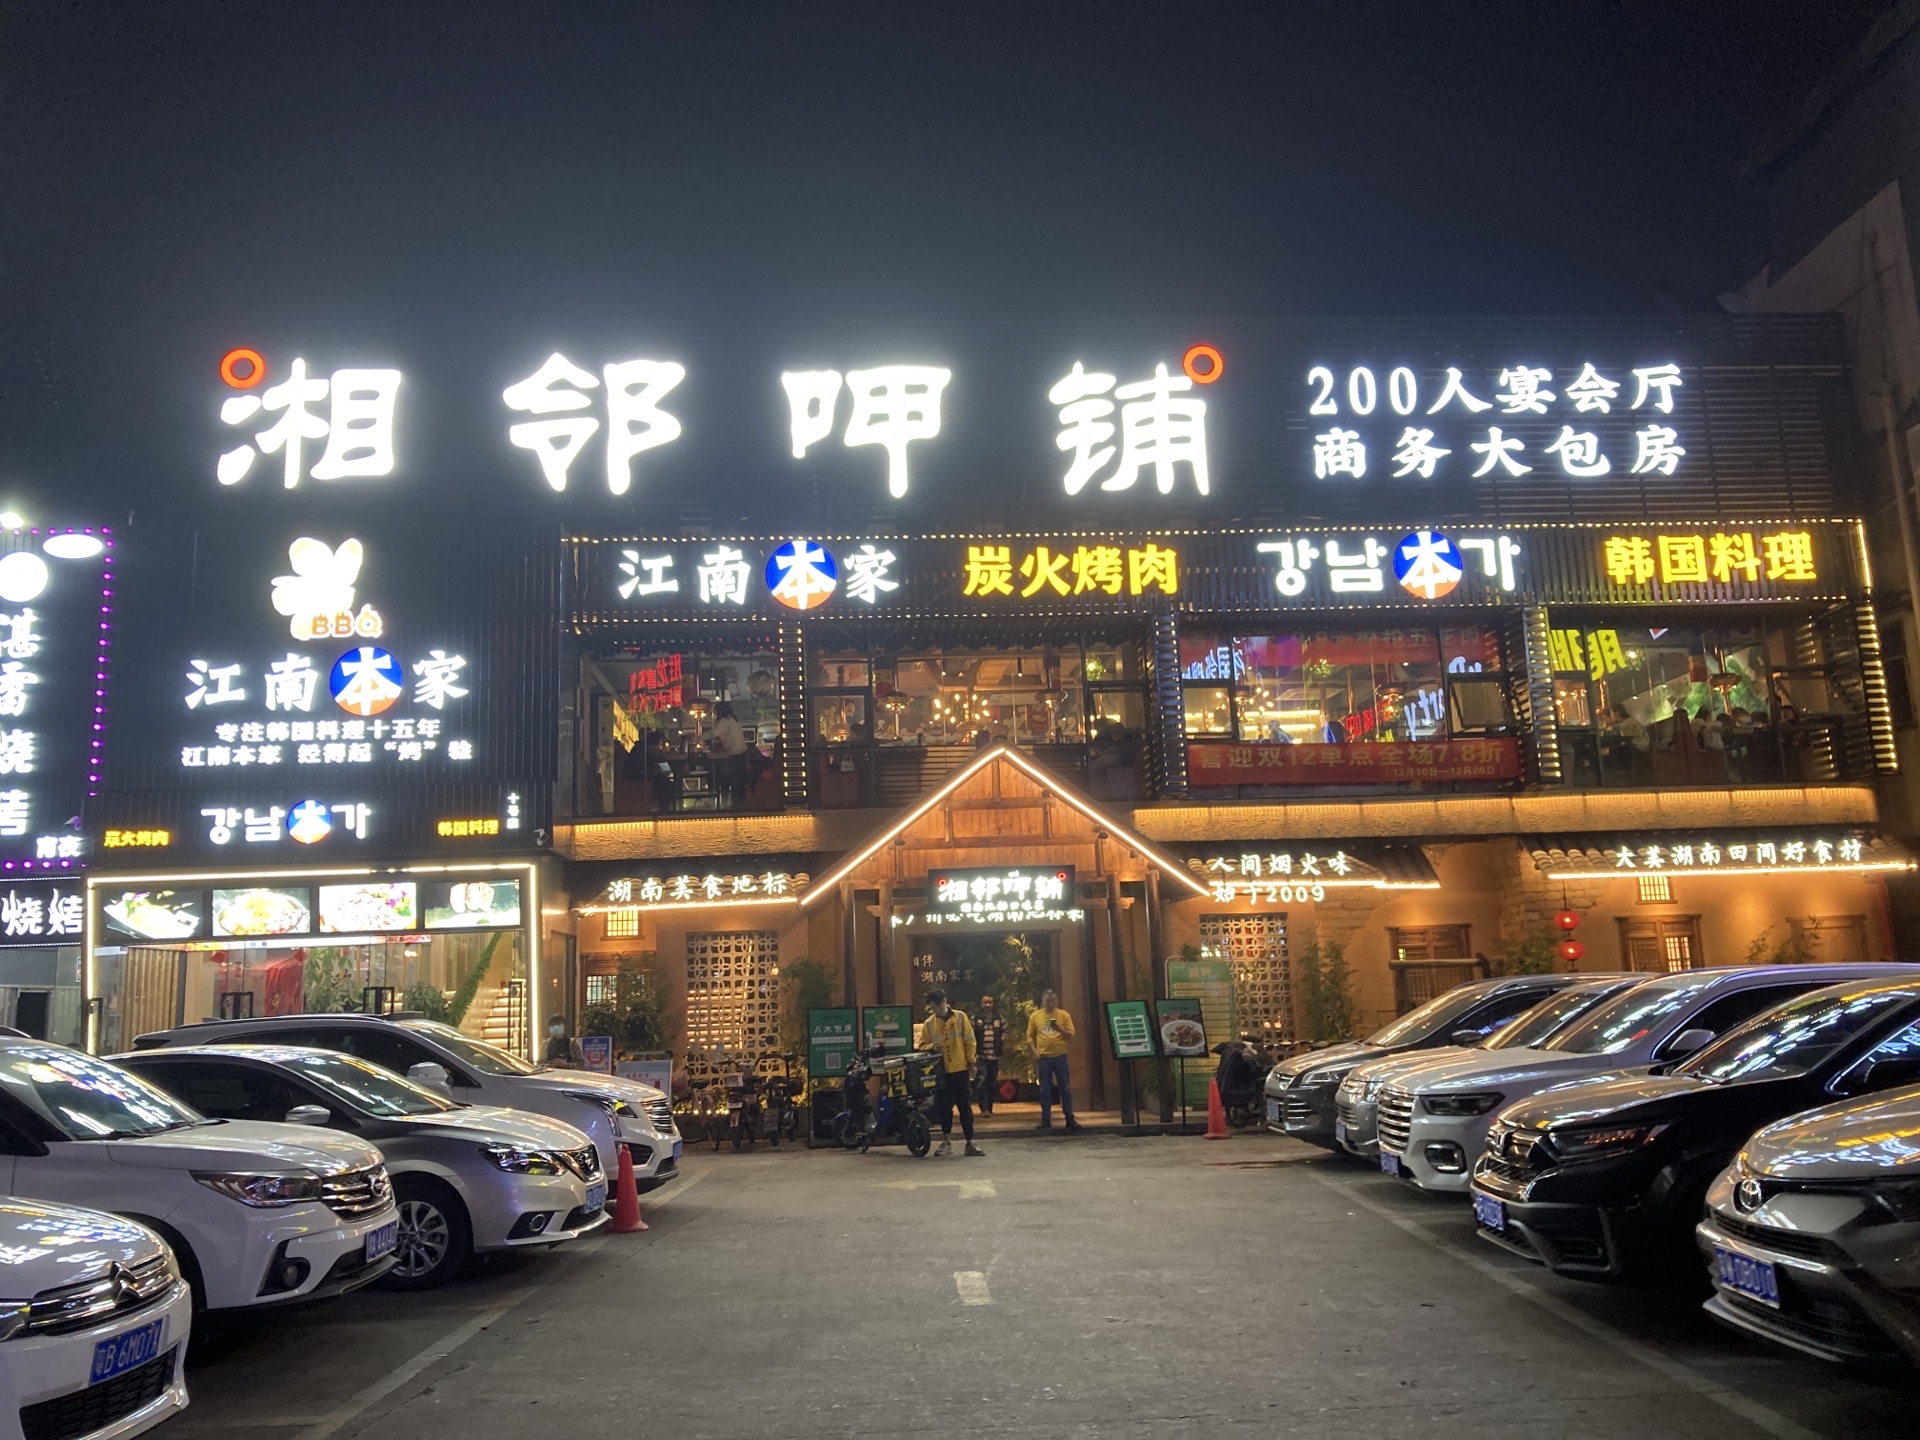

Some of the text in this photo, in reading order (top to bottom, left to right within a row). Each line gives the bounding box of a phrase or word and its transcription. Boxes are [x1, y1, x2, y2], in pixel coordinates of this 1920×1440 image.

[1308, 363, 1684, 415] 200人宴会厅
[217, 345, 1223, 497] 湘邻呷铺
[1313, 424, 1687, 480] 商务大包房
[963, 544, 1178, 598] 炭火烤肉
[1605, 532, 1817, 584] 韩国料理
[618, 541, 899, 610] 江南本家
[310, 606, 382, 637] BBQ
[185, 647, 469, 716] 江南本家
[215, 719, 441, 743] 专注韩国料理十五年
[181, 745, 282, 767] 江南本家
[438, 820, 499, 837] 韩国料理
[1210, 851, 1352, 877] 人间烟火味
[1616, 839, 1862, 868] 大美湖南田间好食材
[608, 872, 788, 902] 湖南美食地标
[1212, 884, 1325, 905] 始于2009
